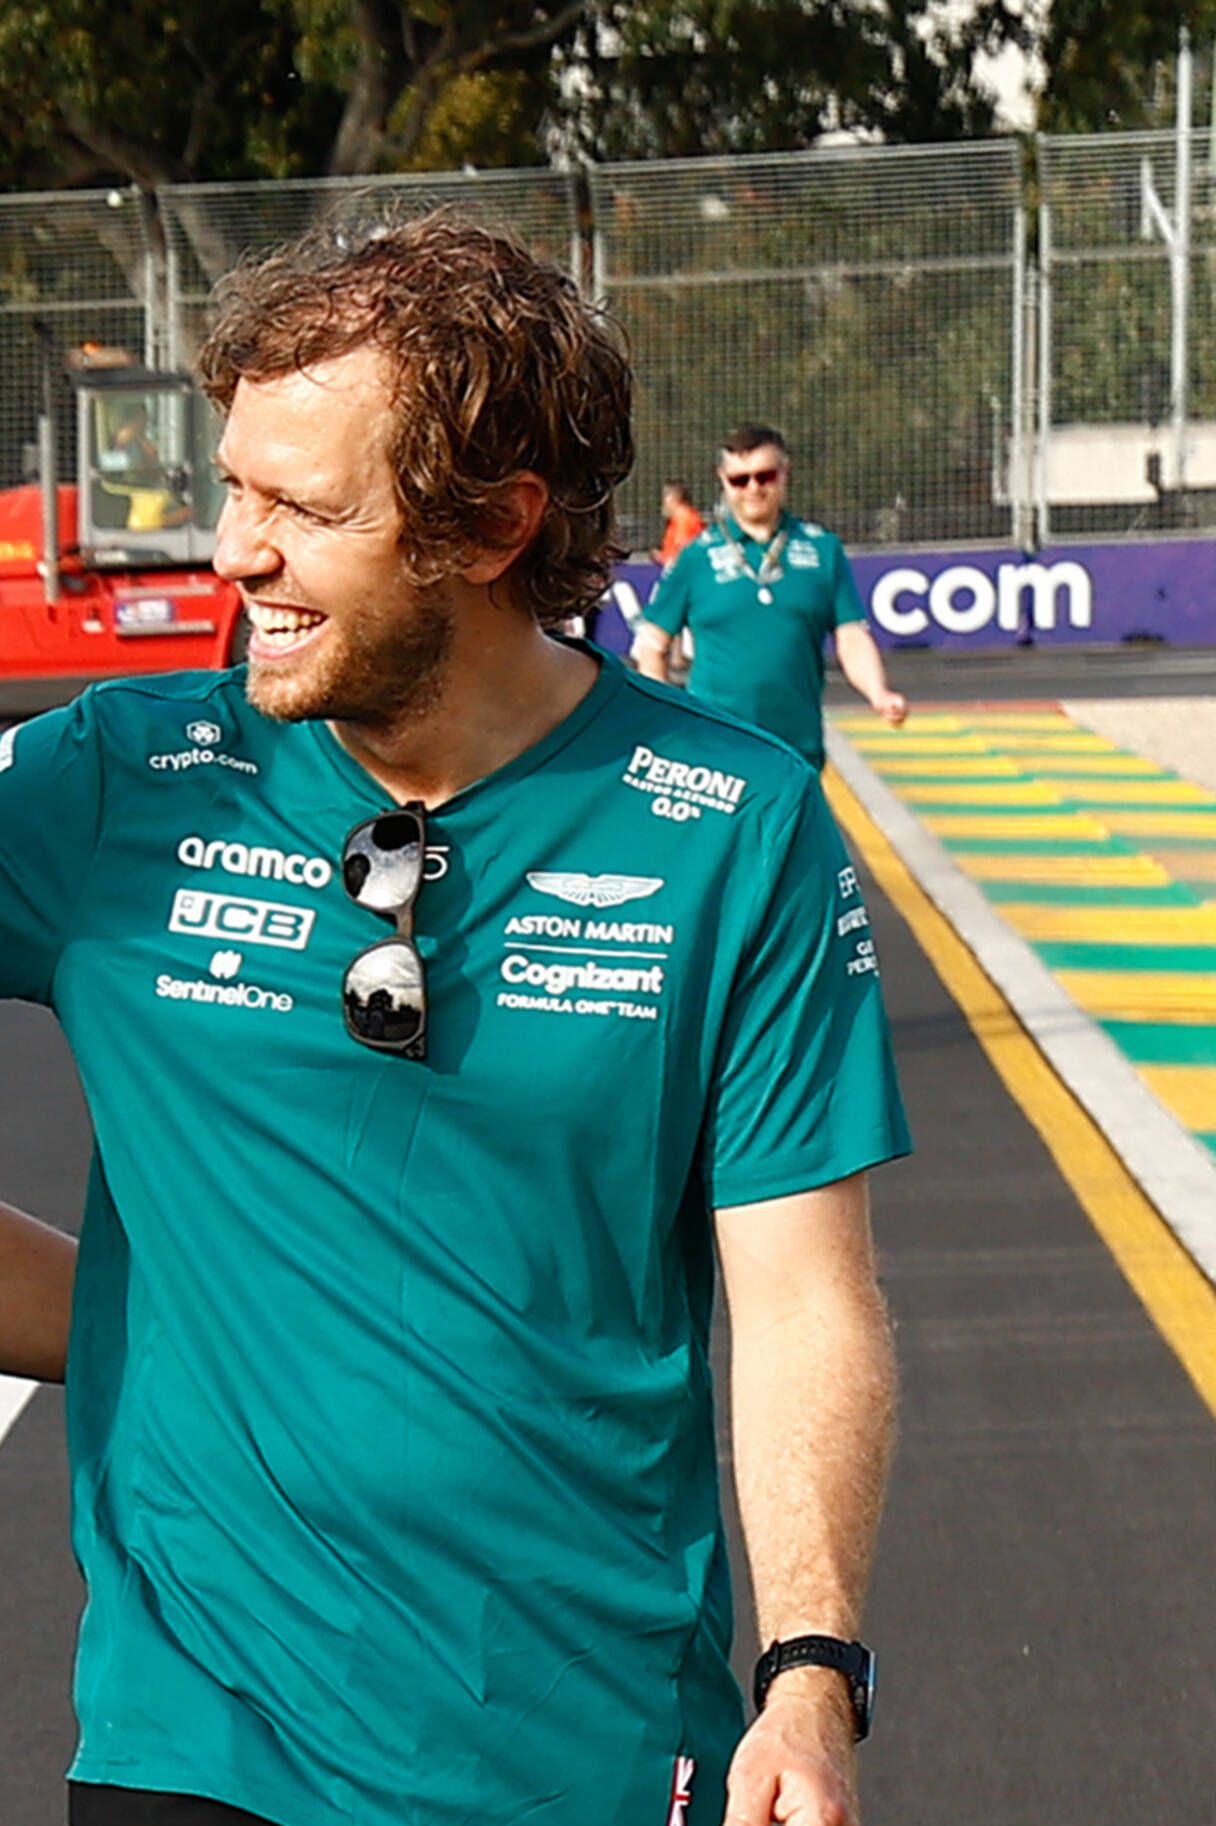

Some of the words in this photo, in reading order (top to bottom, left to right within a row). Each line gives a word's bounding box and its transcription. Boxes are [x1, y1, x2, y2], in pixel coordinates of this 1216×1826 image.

[149, 747, 258, 775] crypto.com
[627, 745, 746, 803] PERONI
[177, 837, 332, 888] aramco
[177, 896, 305, 942] JCB
[504, 916, 581, 938] ASTON
[585, 920, 673, 944] MARTIN
[501, 954, 664, 994] Cognizant
[156, 975, 294, 1013] SentinelOne
[497, 993, 574, 1013] FORMULA
